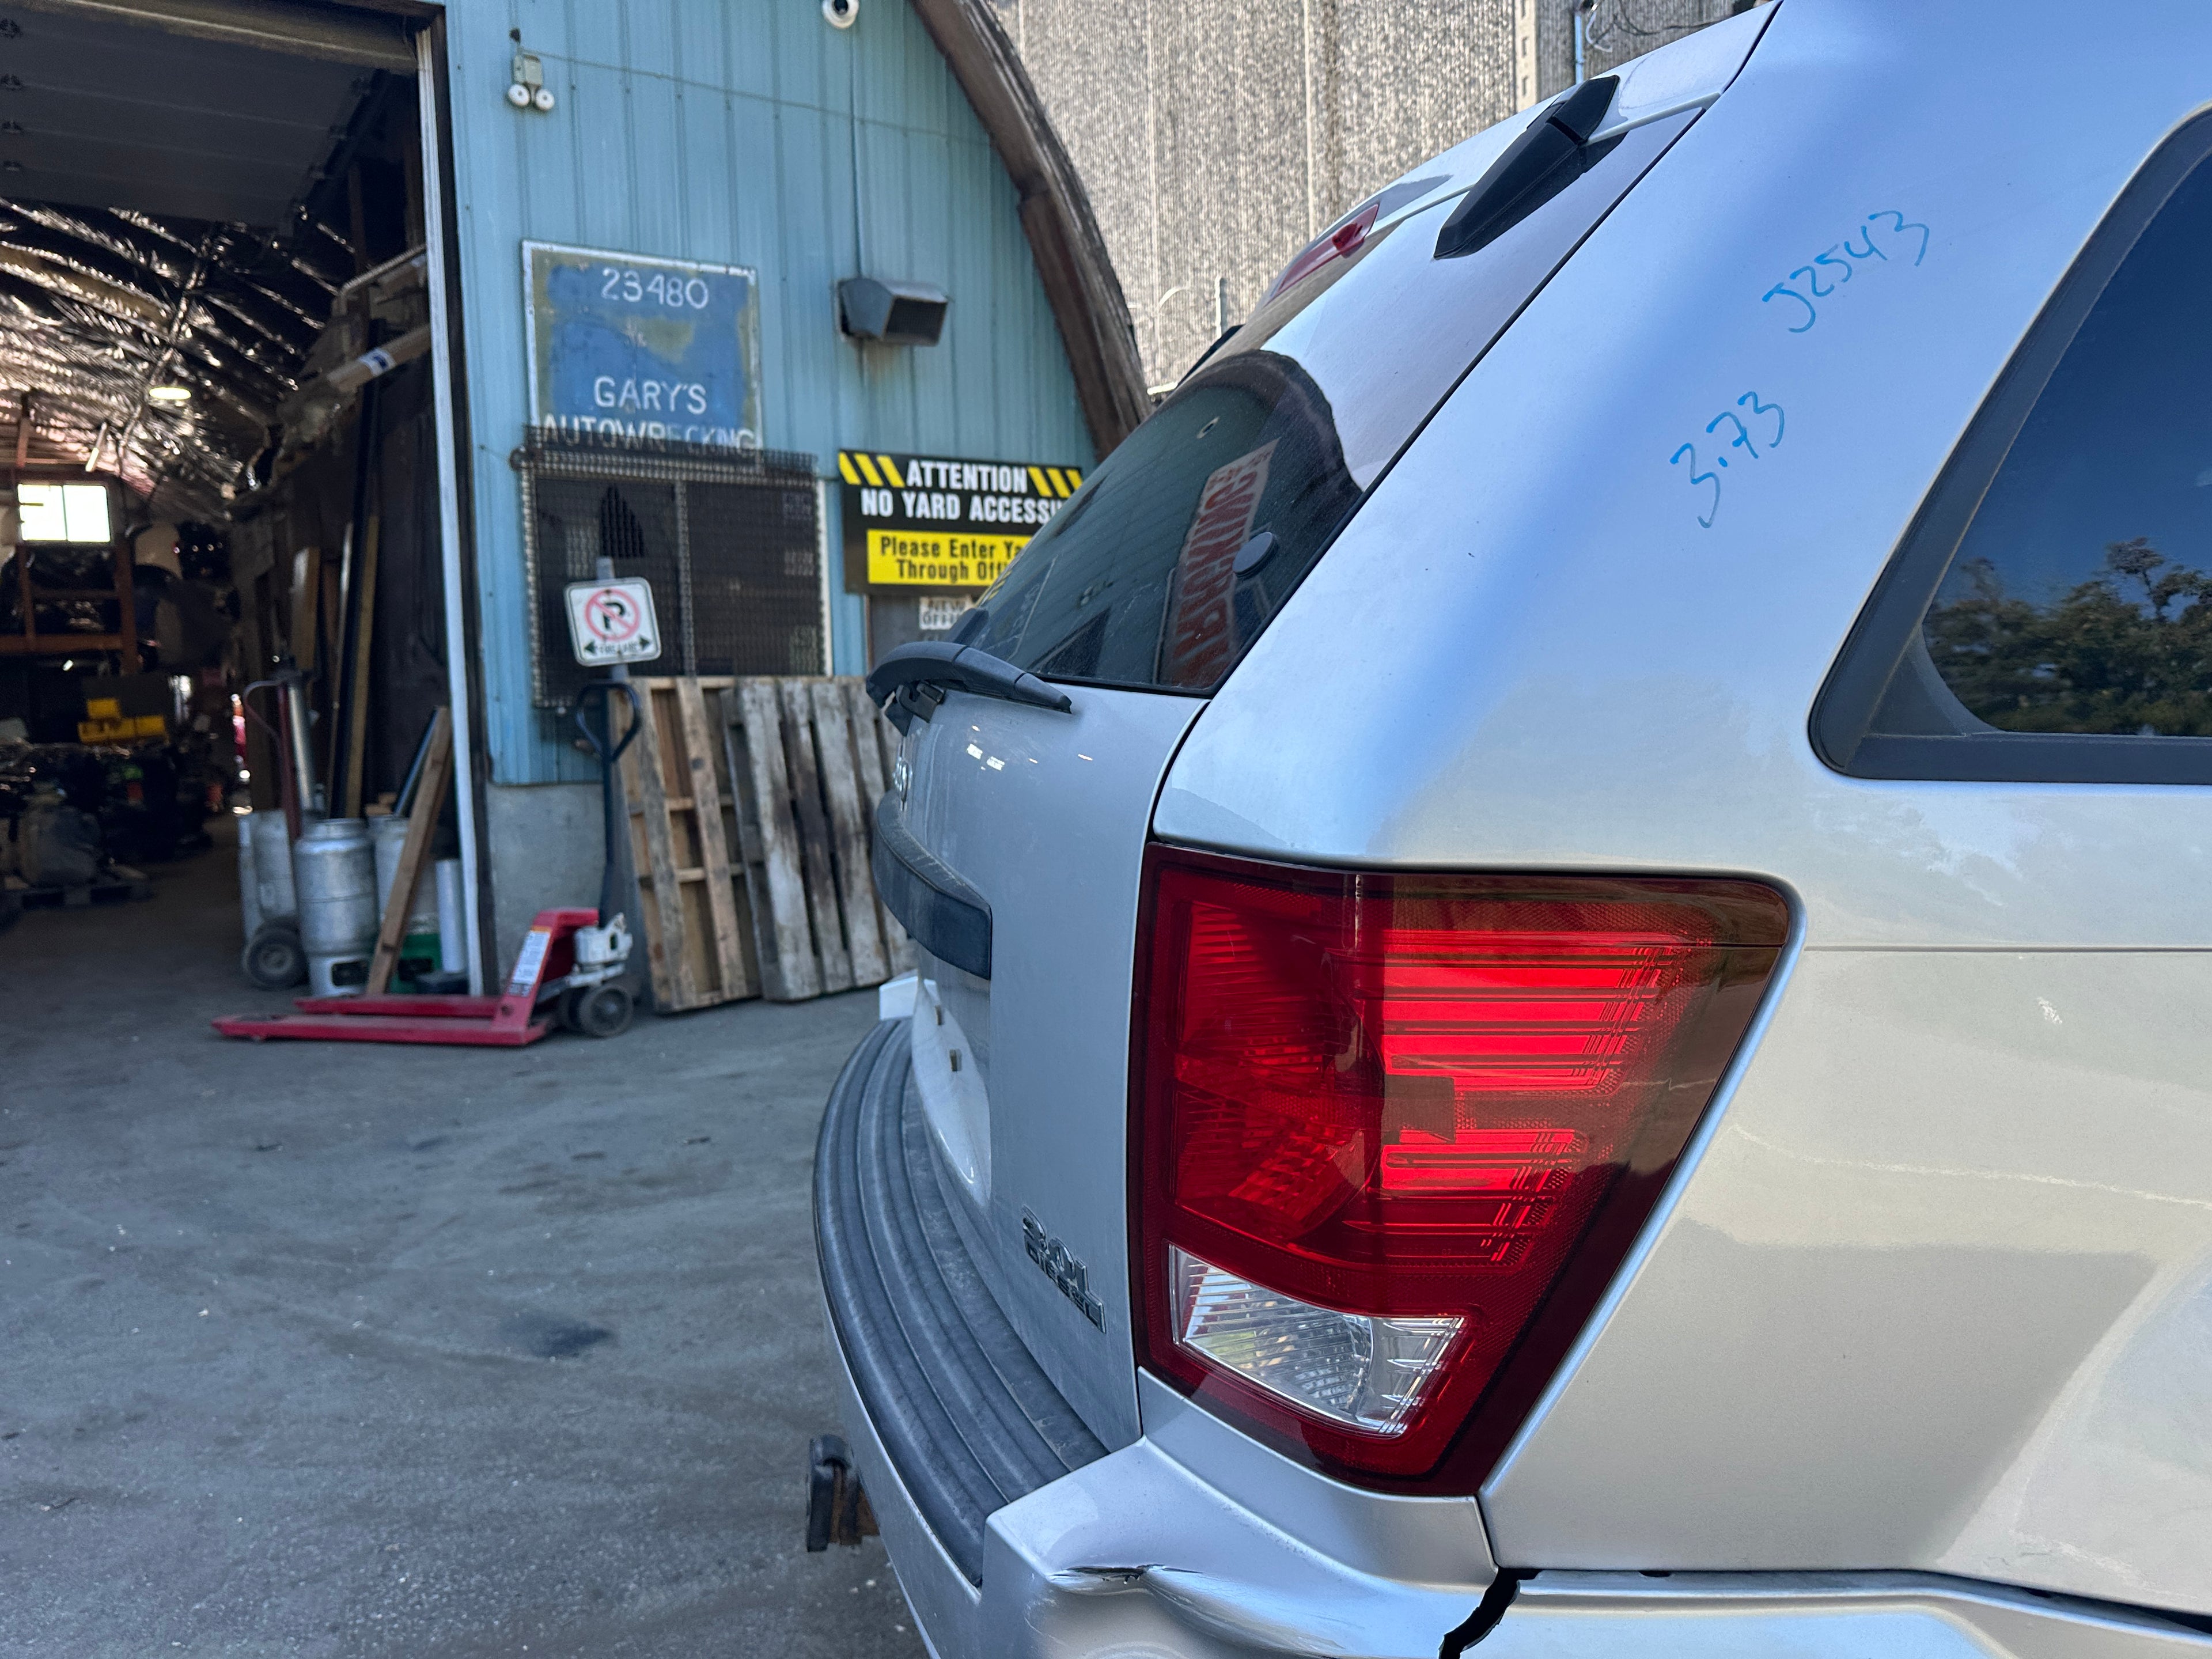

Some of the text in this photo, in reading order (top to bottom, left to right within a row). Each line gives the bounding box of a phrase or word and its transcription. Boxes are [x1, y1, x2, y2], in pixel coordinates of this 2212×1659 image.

[601, 267, 710, 309] 23480
[1762, 210, 1930, 333] J2543
[593, 375, 707, 415] GARY'S
[906, 459, 1028, 494] ATTENTION
[1669, 391, 1785, 528] 3.73
[860, 488, 893, 517] NO
[901, 491, 961, 521] YARD
[880, 535, 941, 558] Please
[949, 538, 997, 559] Enter
[896, 558, 969, 584] Through
